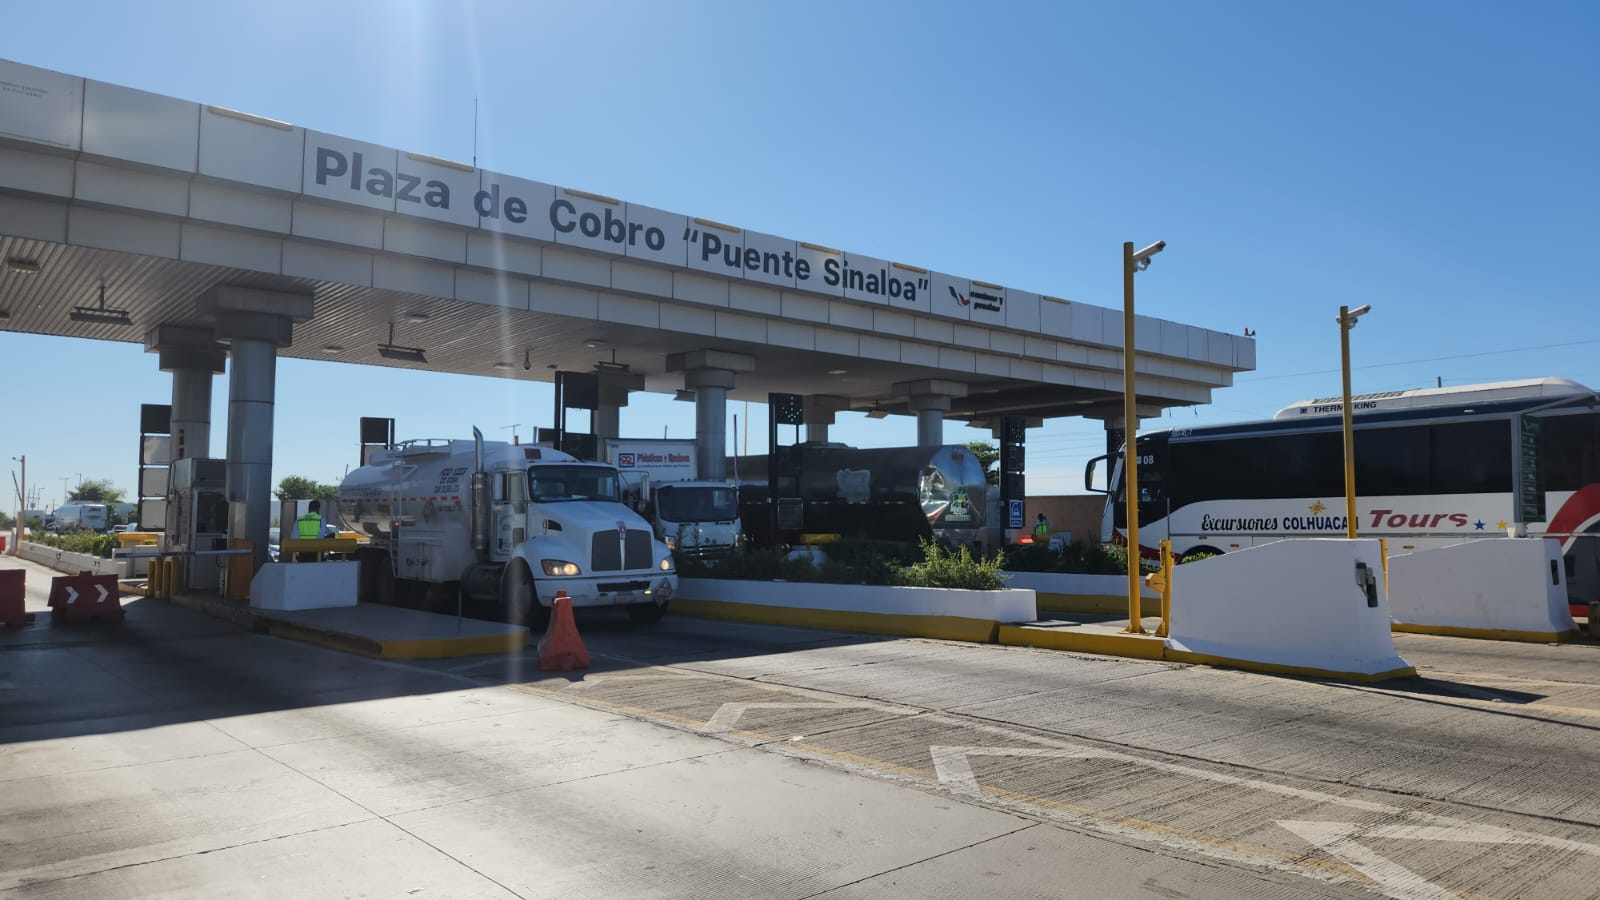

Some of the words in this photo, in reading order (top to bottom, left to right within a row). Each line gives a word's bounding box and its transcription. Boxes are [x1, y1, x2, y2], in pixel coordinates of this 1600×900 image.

[315, 147, 450, 210] Plaza
[474, 184, 528, 224] de
[549, 199, 665, 251] Cobro
[1353, 401, 1377, 410] KING
[1201, 513, 1278, 531] Excursiones
[1283, 516, 1359, 530] COLHUACA
[1369, 509, 1469, 529] Tours
